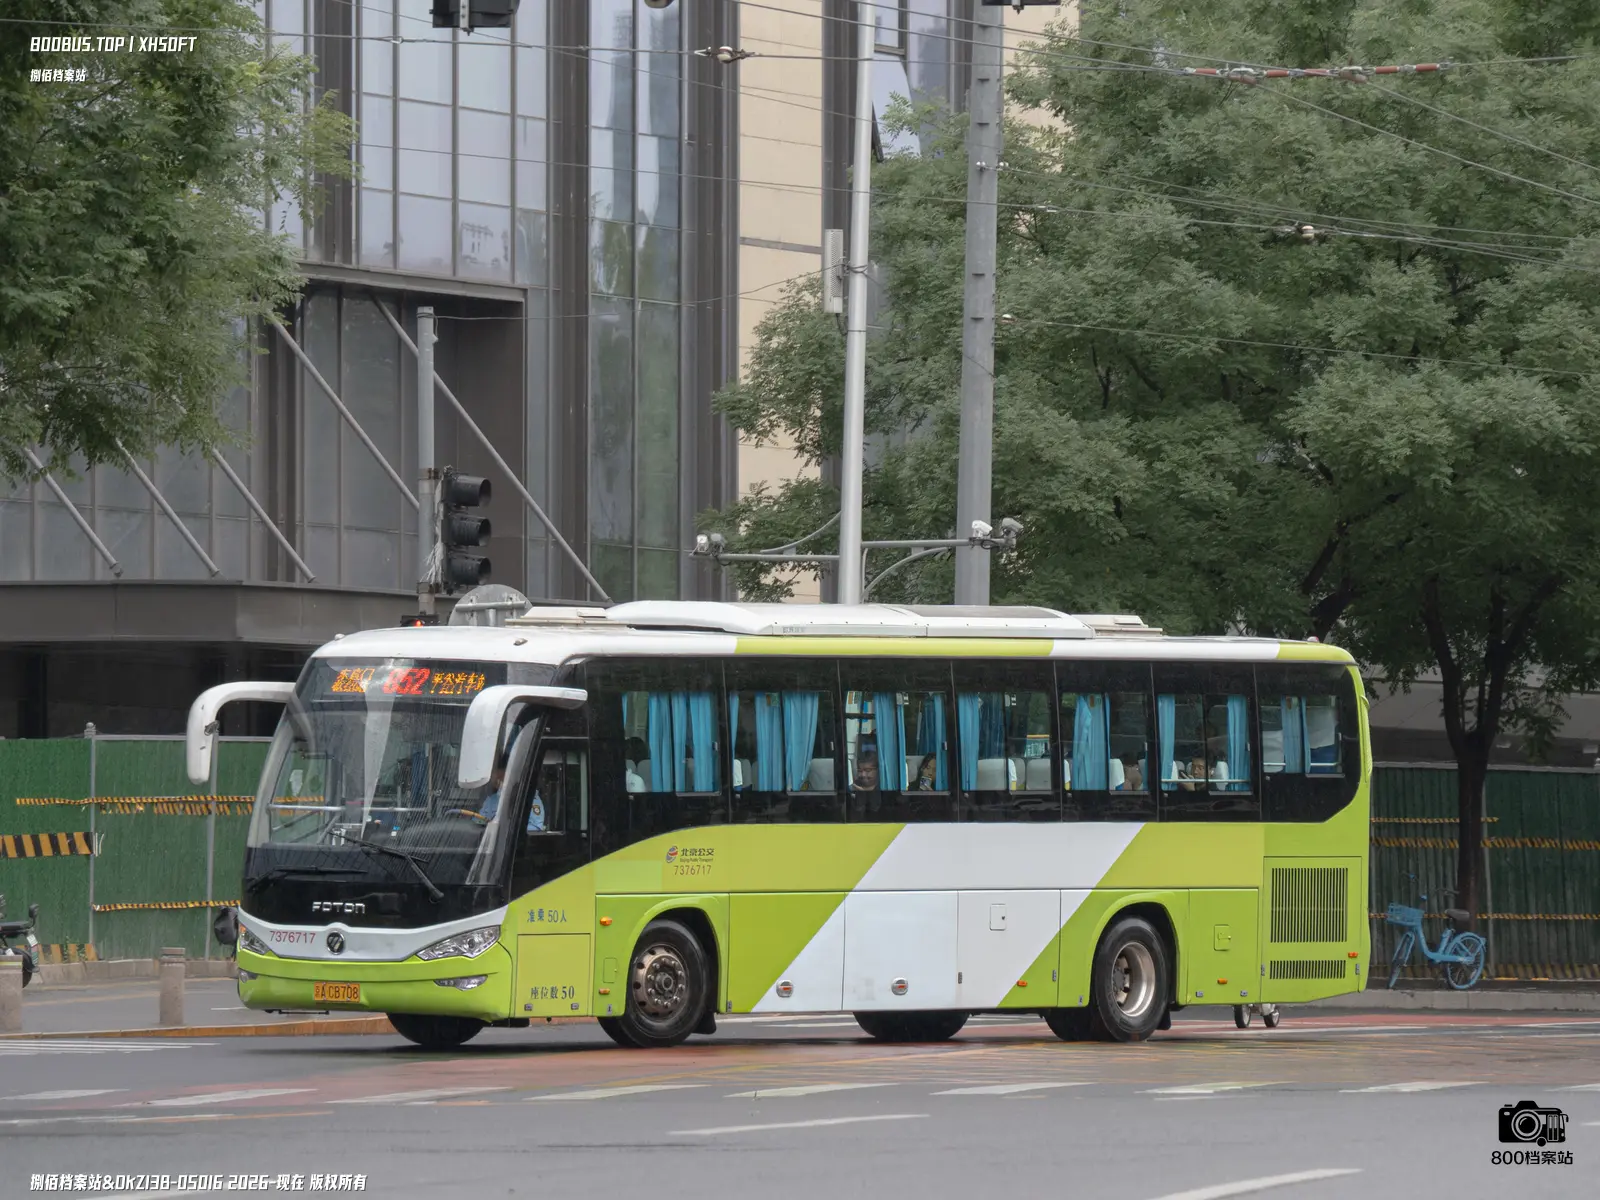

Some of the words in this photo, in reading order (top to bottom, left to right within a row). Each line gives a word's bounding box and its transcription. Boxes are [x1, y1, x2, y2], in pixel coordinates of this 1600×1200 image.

[383, 667, 431, 695] 852
[681, 848, 714, 856] 北京公交
[674, 865, 711, 875] 7376717
[312, 901, 366, 914] FOTON
[527, 908, 567, 923] 准乘50人
[269, 930, 316, 944] 7376717
[530, 985, 575, 1000] 座位数50
